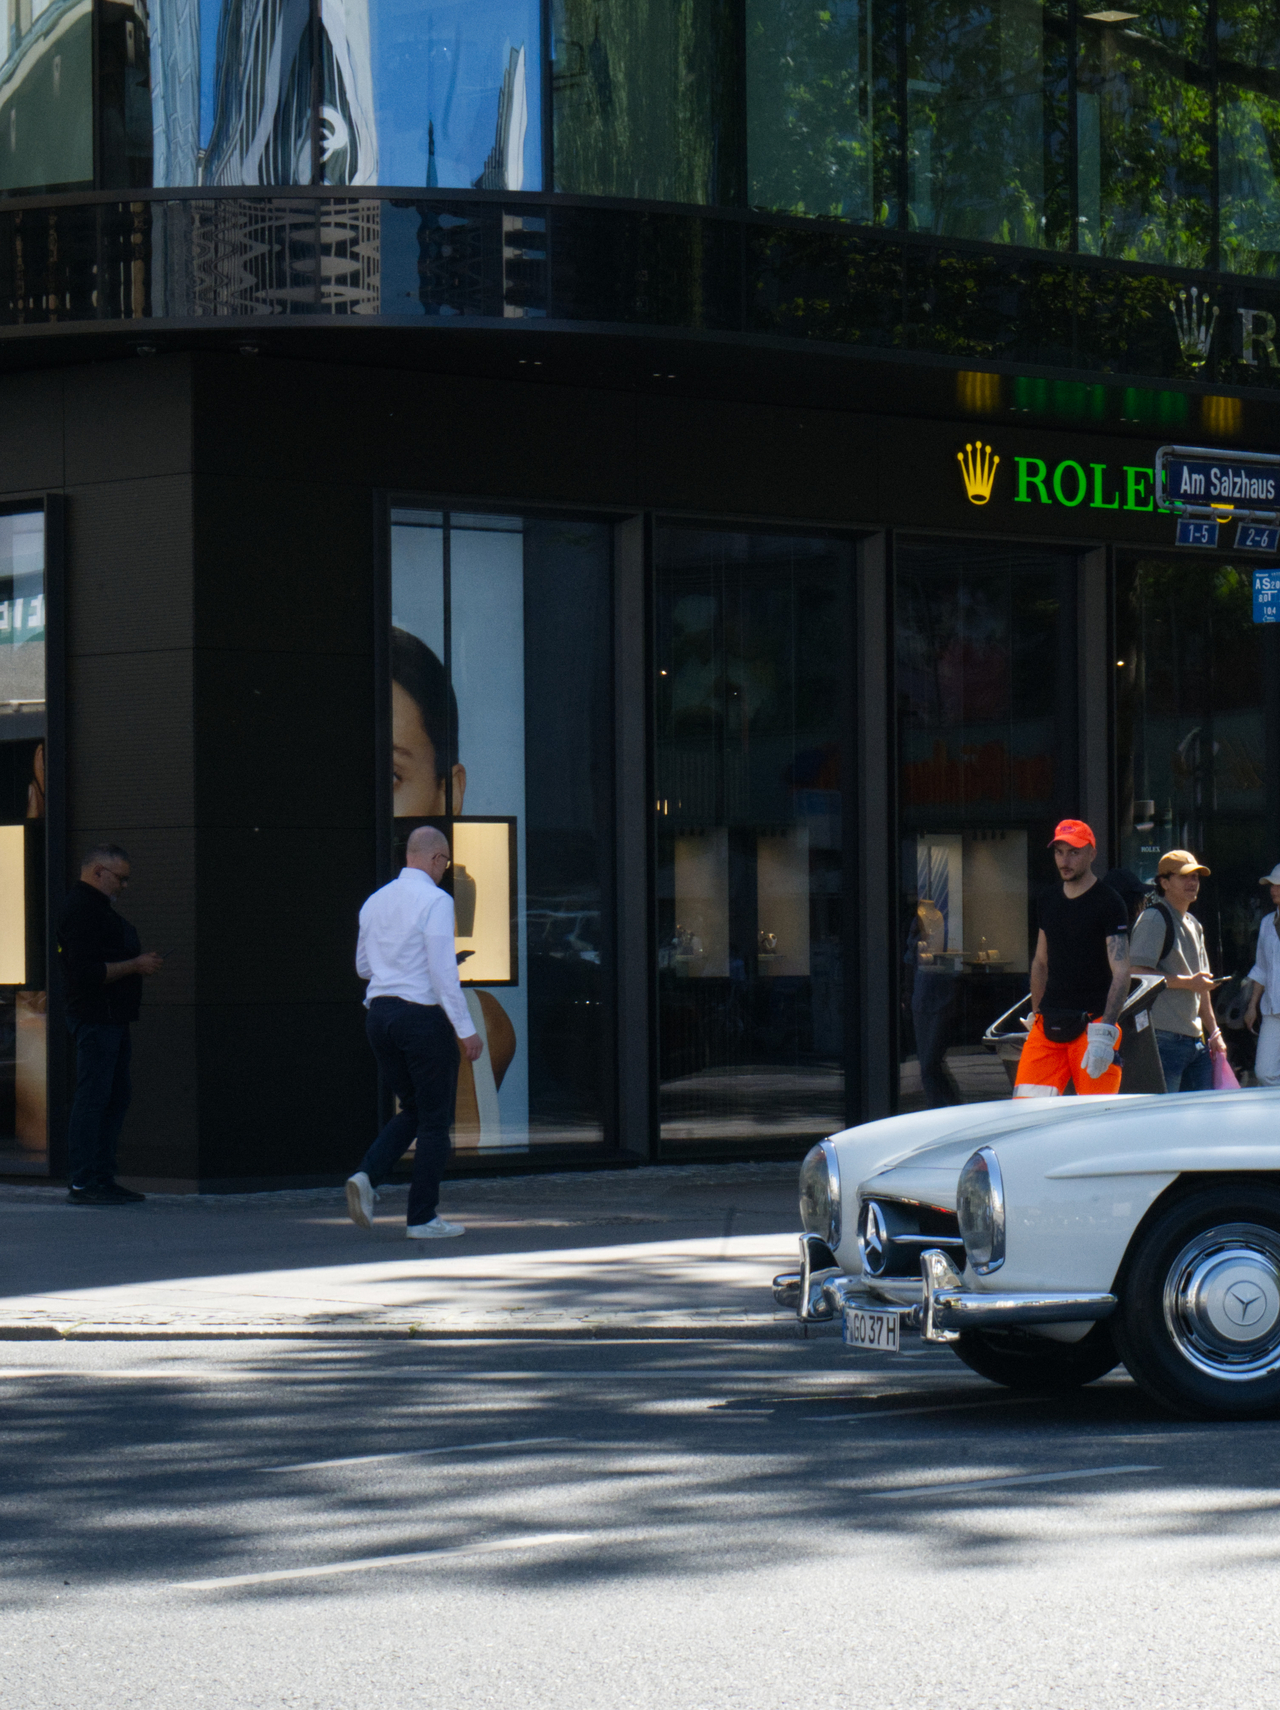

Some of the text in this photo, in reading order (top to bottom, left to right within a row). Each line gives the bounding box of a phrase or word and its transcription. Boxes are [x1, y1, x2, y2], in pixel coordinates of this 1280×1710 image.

[1014, 456, 1182, 515] ROLE
[1180, 465, 1275, 500] Am Salzhaus
[1188, 524, 1209, 543] 1-5
[1246, 529, 1269, 547] 2-6
